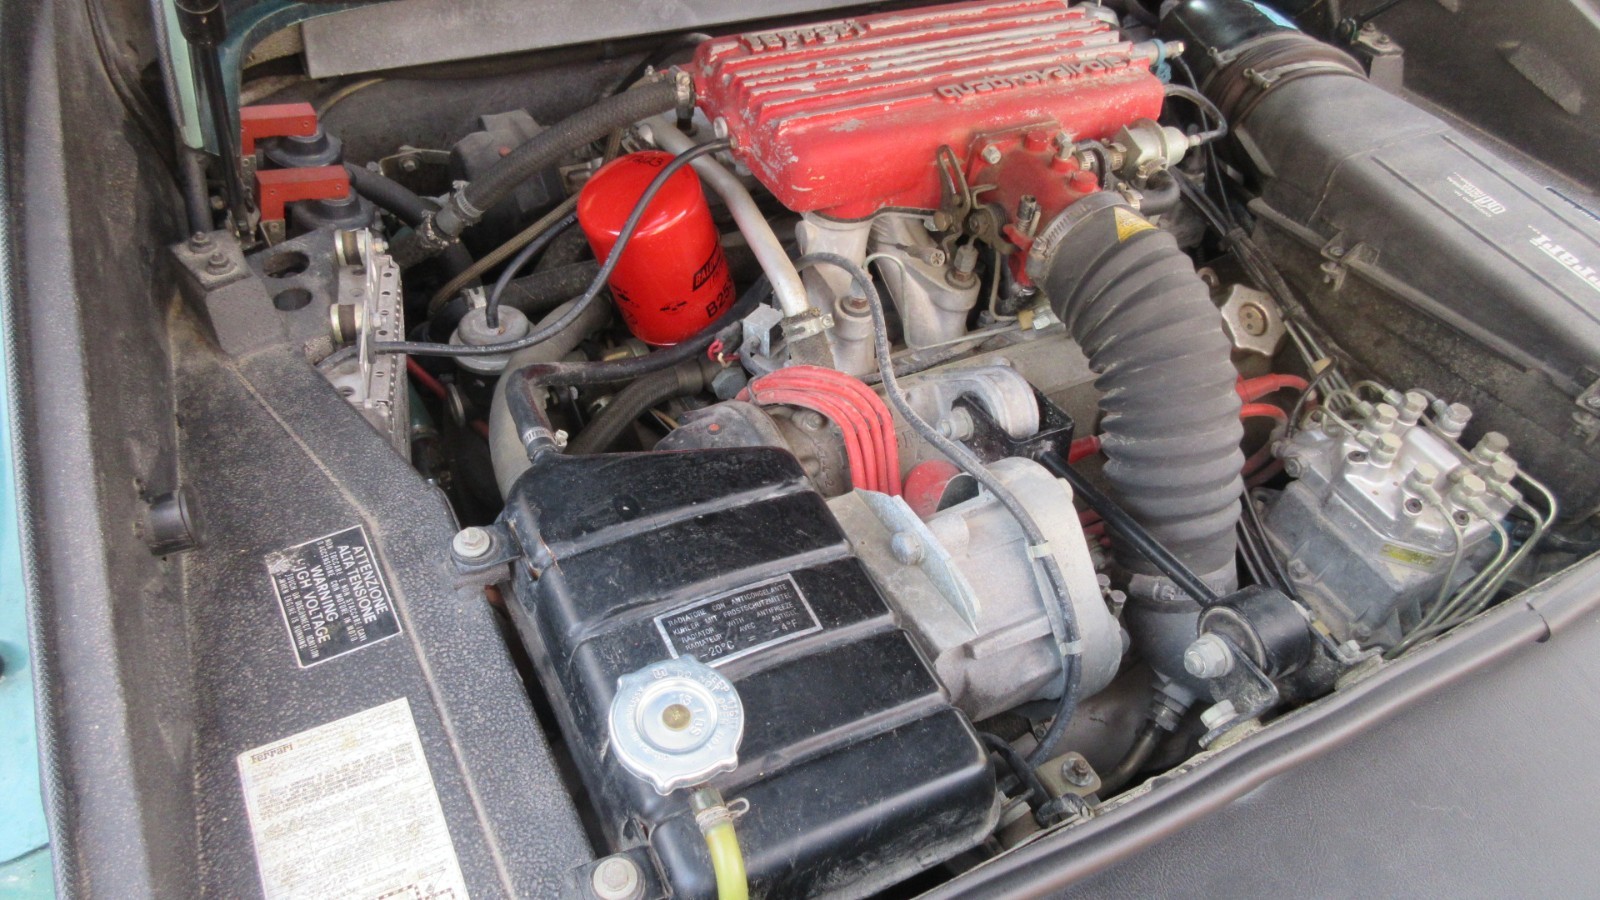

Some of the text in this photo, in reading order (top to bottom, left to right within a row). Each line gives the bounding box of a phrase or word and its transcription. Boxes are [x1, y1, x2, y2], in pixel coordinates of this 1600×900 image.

[311, 564, 339, 622] WARNING
[338, 545, 377, 624] ALTA TENSIONE
[353, 546, 388, 615] ATTENZIONE
[303, 591, 331, 644] VOLTAGE
[668, 583, 787, 627] RADIATORE CON ANTICONGELANTE
[682, 602, 794, 643] RADIATOR WITH ANTIFREEZE
[685, 634, 723, 651] RADIATEUR
[739, 621, 756, 633] AVEC
[250, 743, 294, 764] Ferrari
